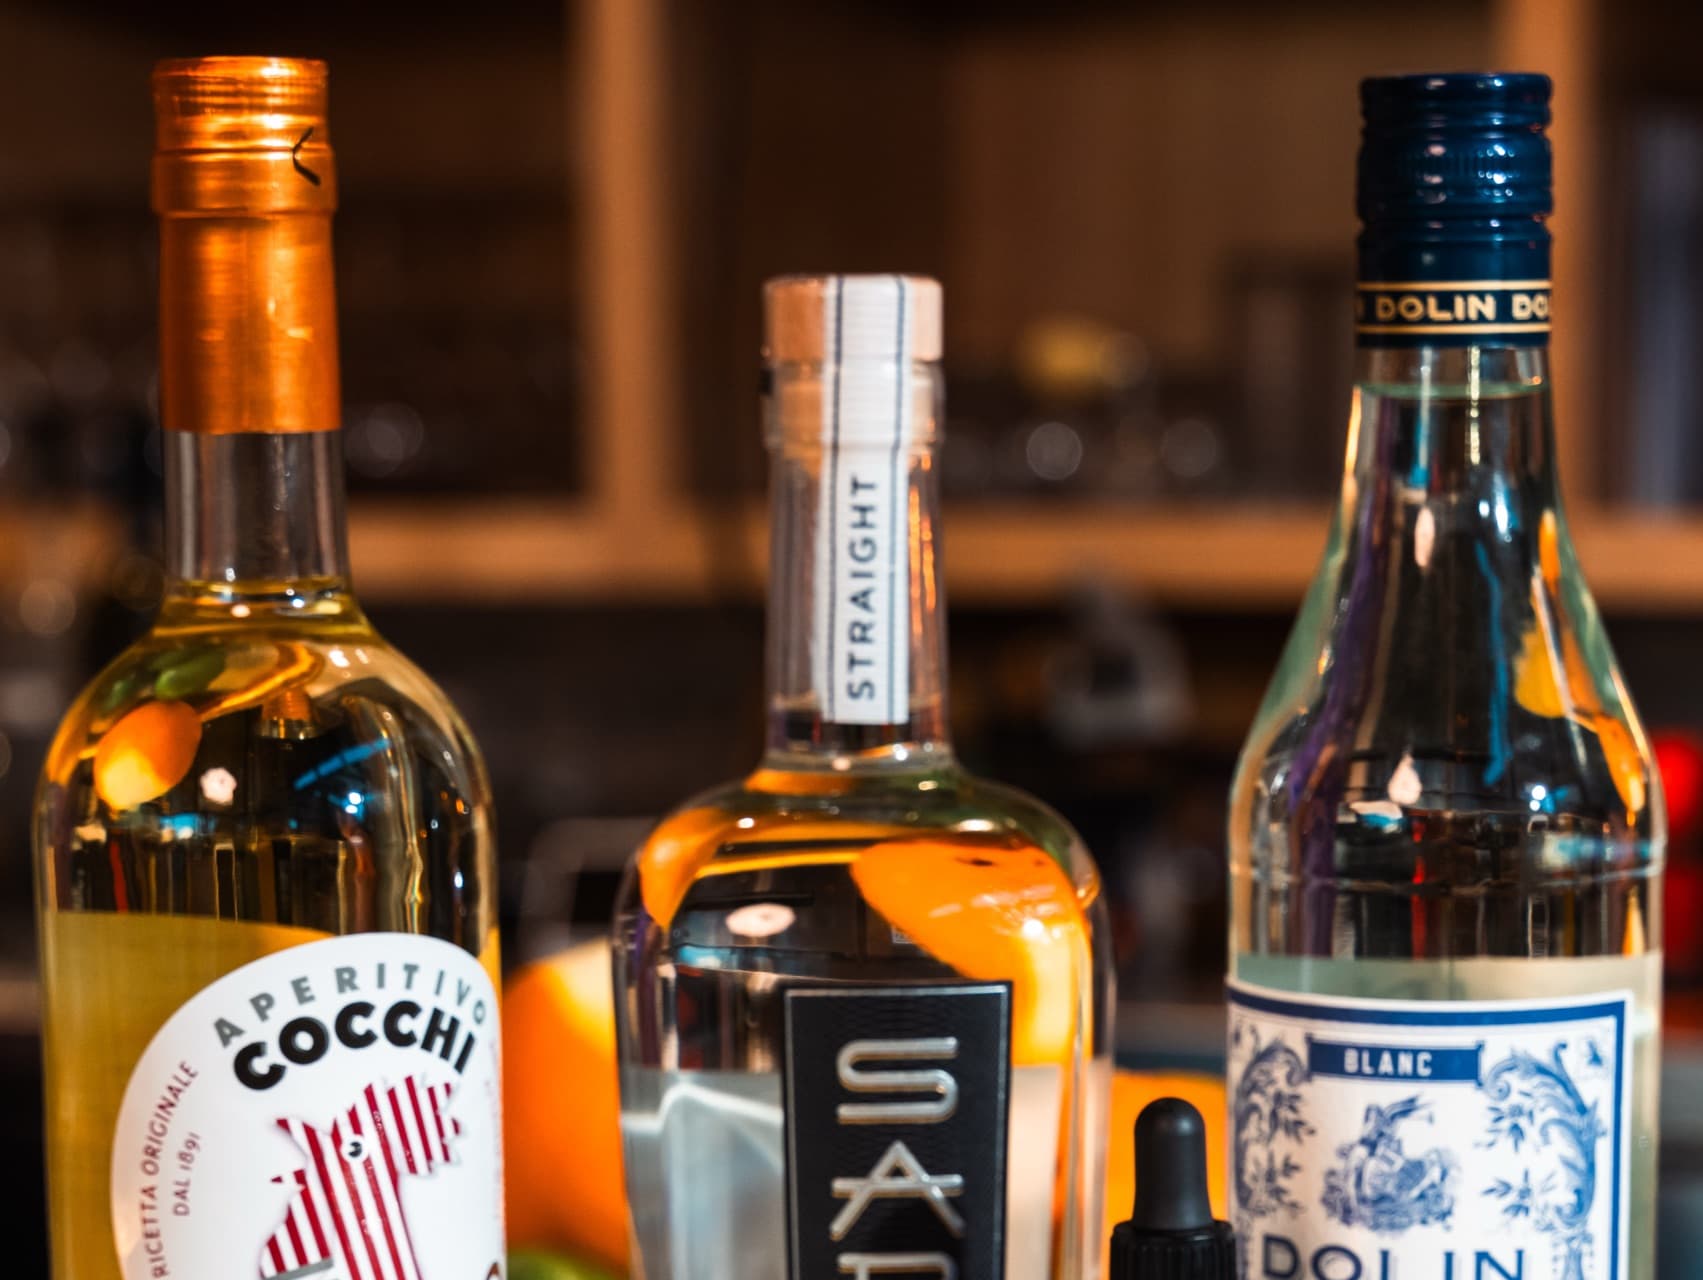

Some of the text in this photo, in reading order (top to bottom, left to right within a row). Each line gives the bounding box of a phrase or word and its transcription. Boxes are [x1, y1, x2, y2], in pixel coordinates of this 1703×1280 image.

[1376, 294, 1496, 321] DOLIN
[847, 476, 877, 701] STRAIGHT
[212, 962, 487, 1048] APERITIVO
[233, 1000, 477, 1091] COCCHI
[1344, 1048, 1433, 1076] BLANC
[140, 1059, 199, 1279] RICETTA ORIGINALE
[173, 1131, 201, 1217] DAL 1891
